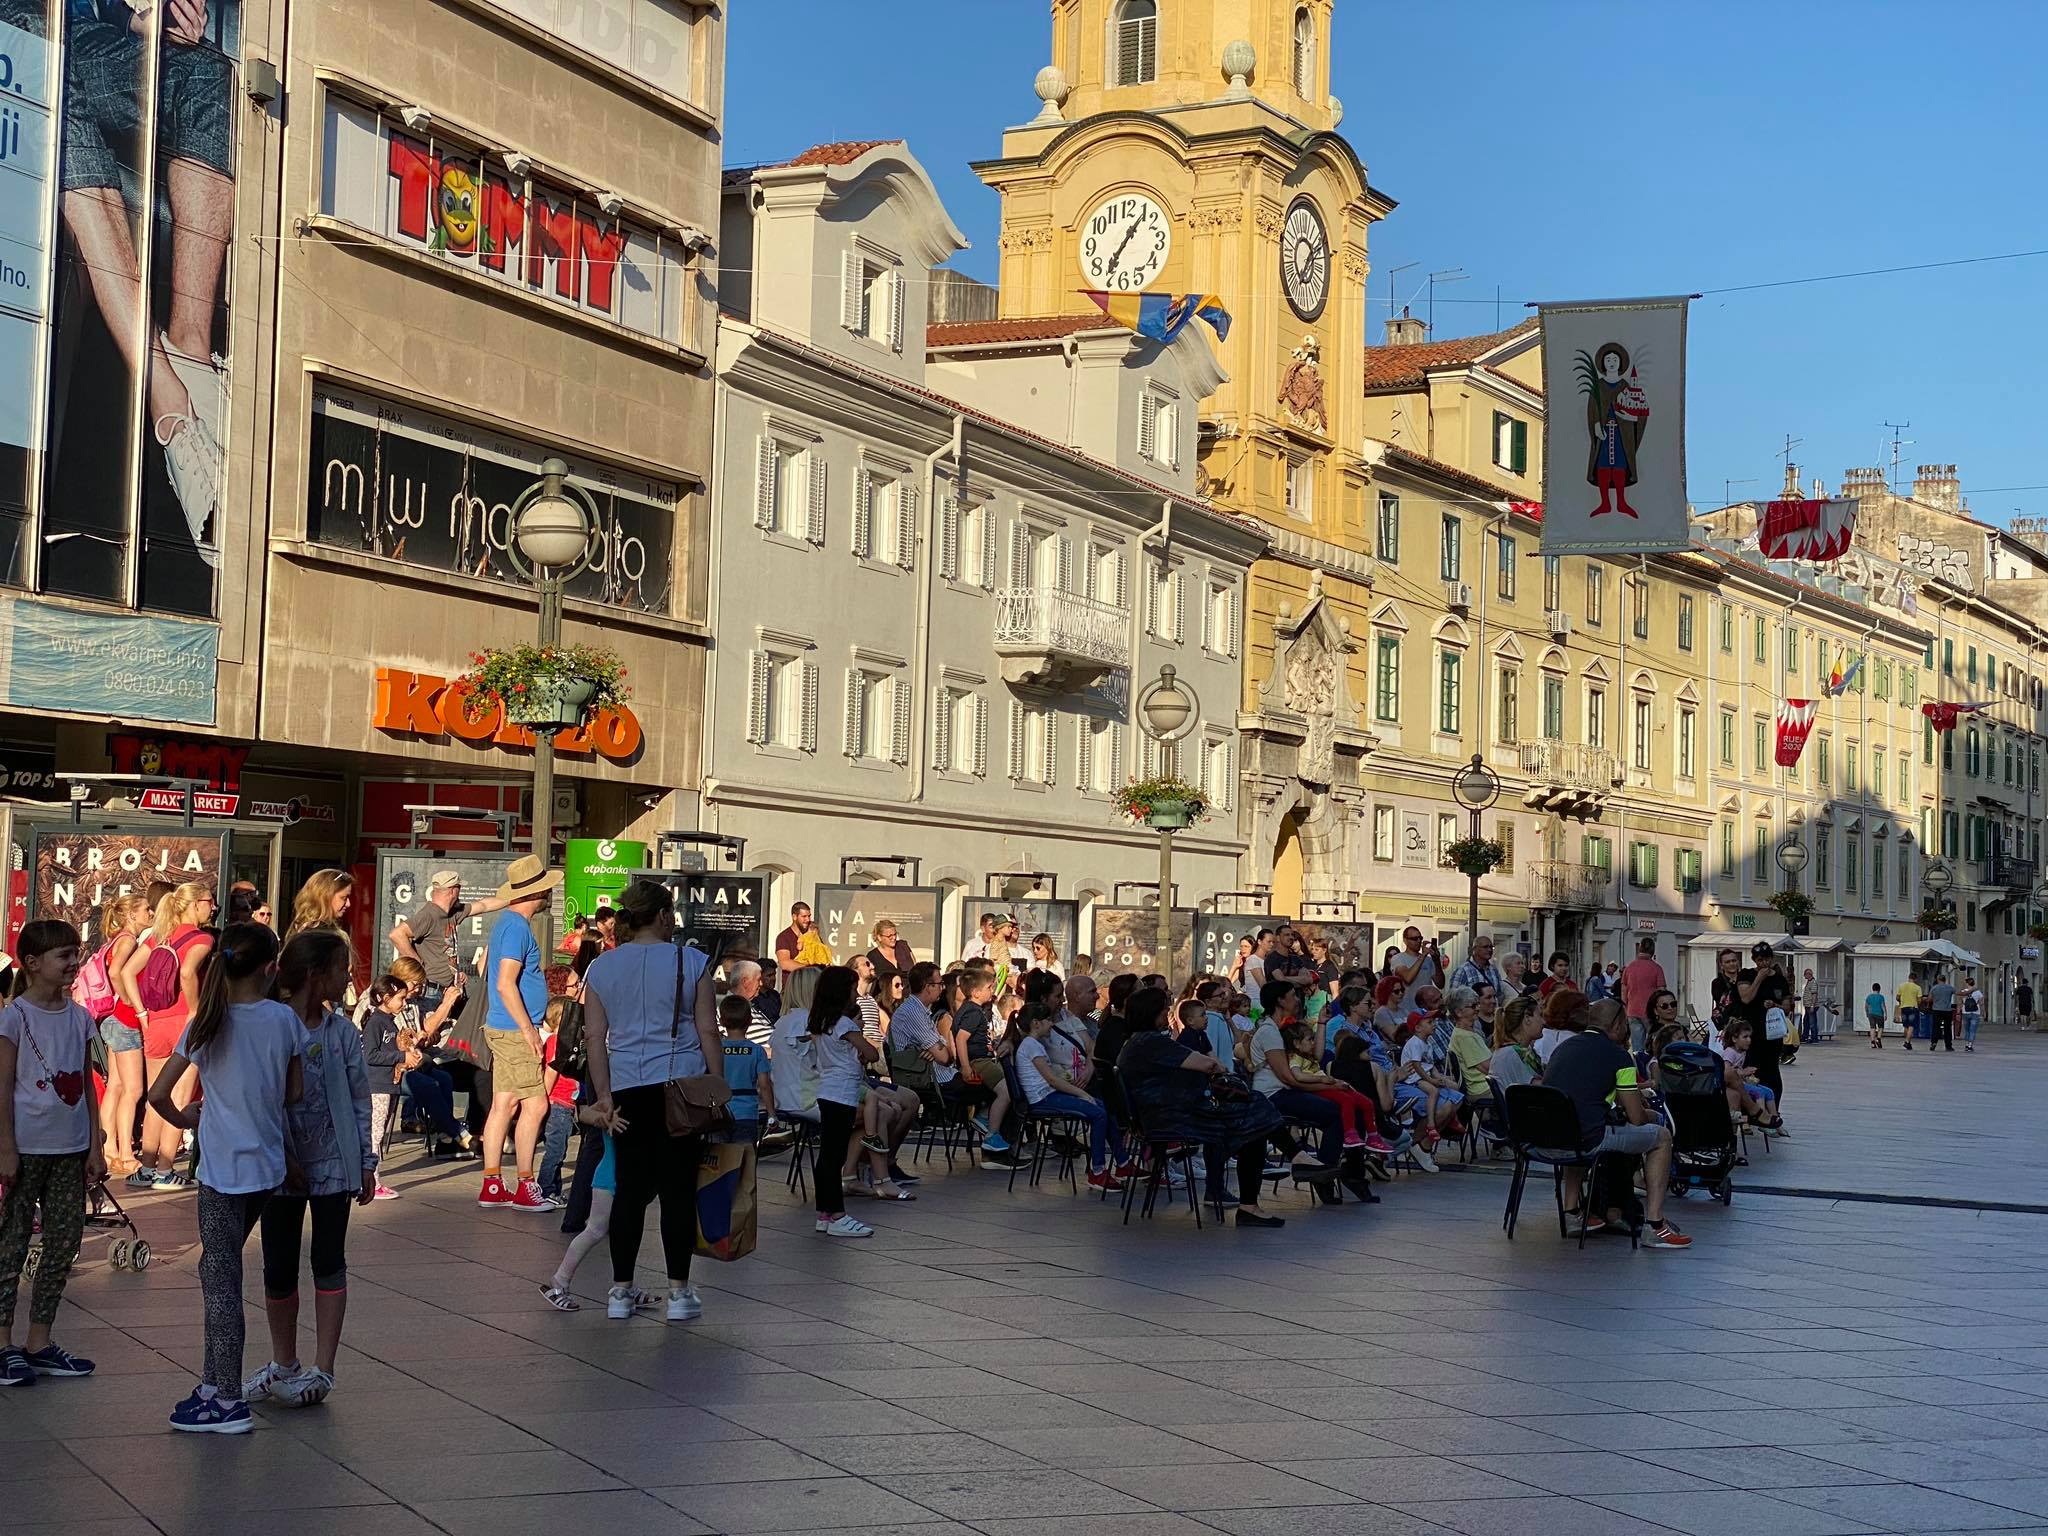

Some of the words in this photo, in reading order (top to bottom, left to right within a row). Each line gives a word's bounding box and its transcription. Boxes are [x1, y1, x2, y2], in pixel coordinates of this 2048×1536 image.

[1107, 205, 1117, 224] 11
[1121, 200, 1136, 219] 12
[389, 128, 631, 313] TOMMY
[1092, 216, 1107, 235] 10
[1149, 212, 1158, 230] 2
[1086, 238, 1096, 257] 9
[1155, 231, 1165, 250] 3
[1091, 257, 1102, 276] 8
[1146, 251, 1158, 269] 4
[1118, 271, 1129, 291] 6
[1134, 265, 1145, 286] 5
[378, 408, 403, 423] BRAX
[656, 486, 673, 506] kat
[12, 771, 42, 787] TOP
[151, 793, 227, 810] MAXRKET
[56, 847, 203, 871] BROJA
[829, 909, 865, 925] NA
[1105, 934, 1135, 947] OD
[1207, 931, 1234, 943] DO
[1104, 952, 1151, 966] POD
[722, 1047, 749, 1055] OLIS
